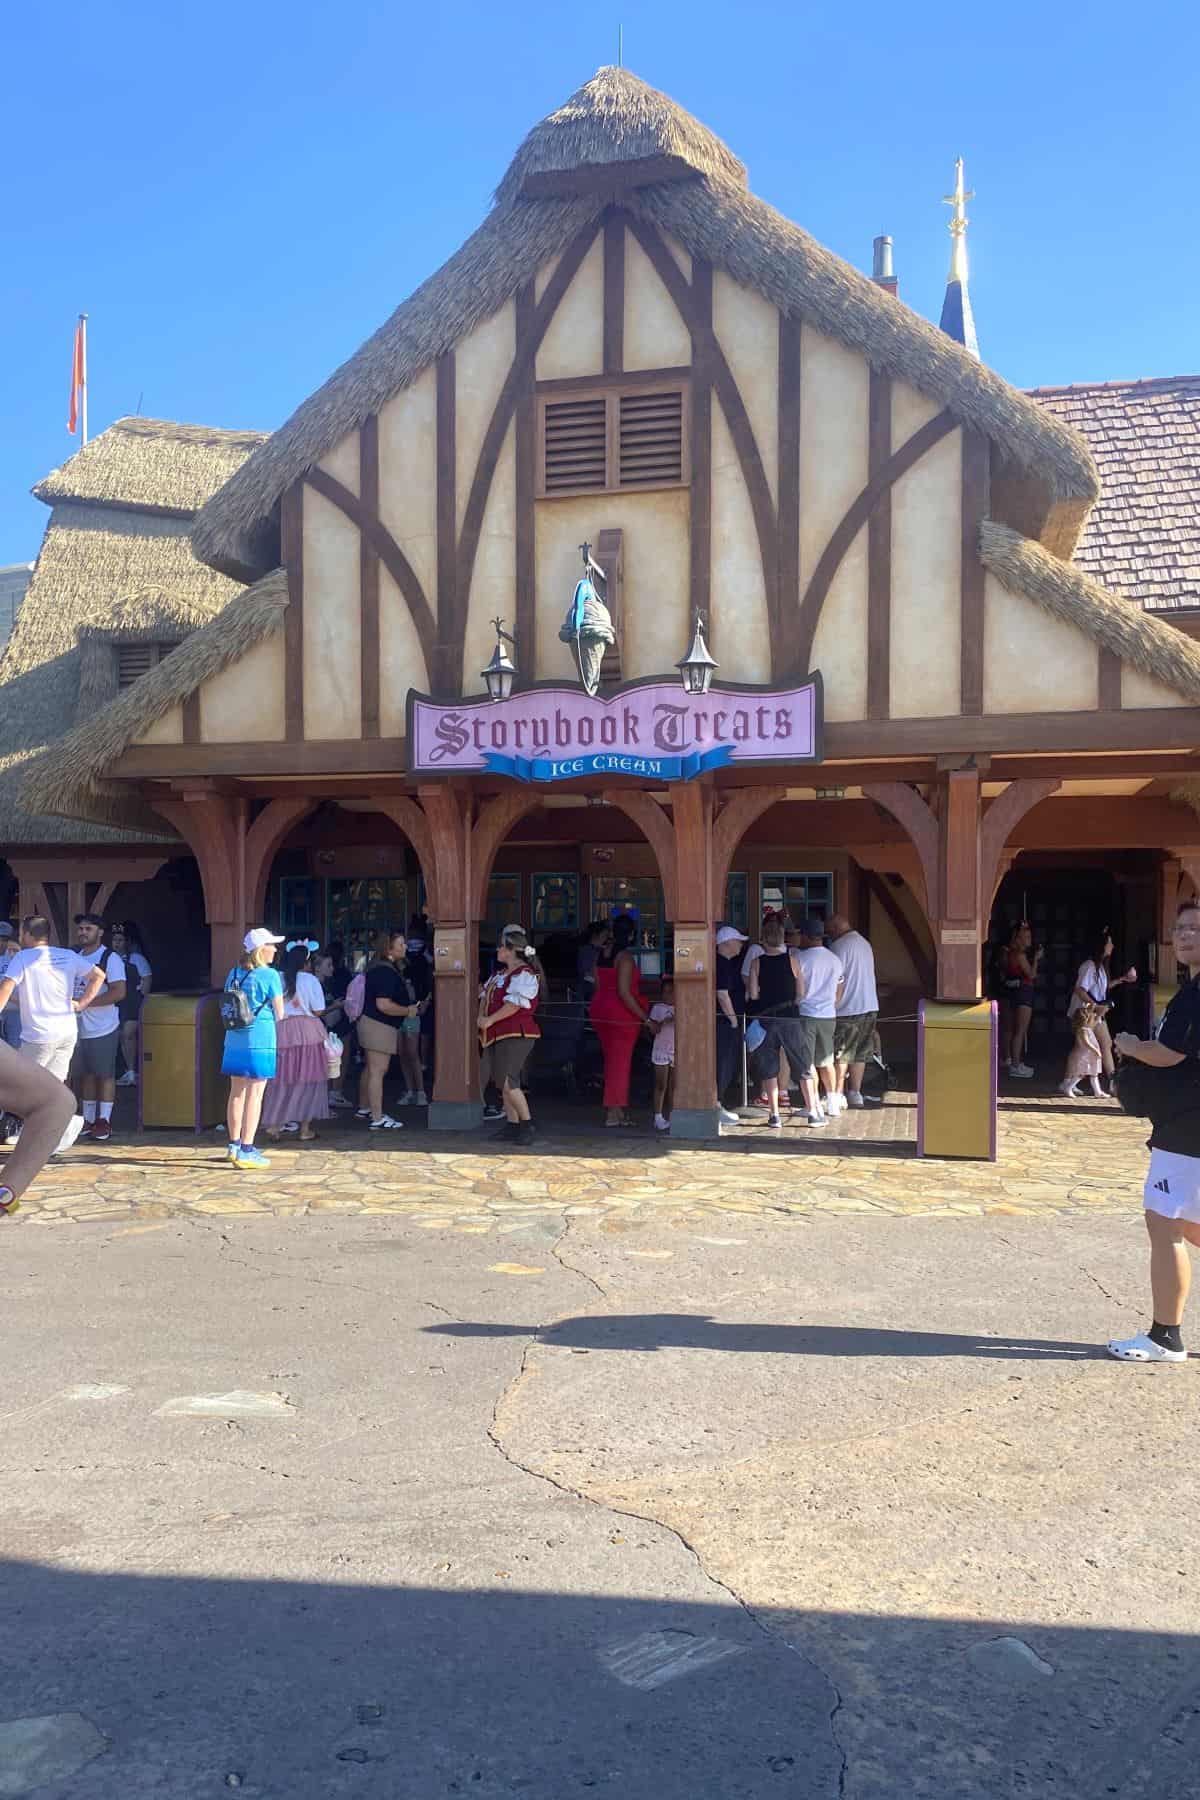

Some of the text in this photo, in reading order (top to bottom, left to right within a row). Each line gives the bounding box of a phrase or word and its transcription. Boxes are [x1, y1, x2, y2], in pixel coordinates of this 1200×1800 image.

[429, 703, 793, 761] Storybook Treats
[551, 755, 661, 776] ICE CREAM
